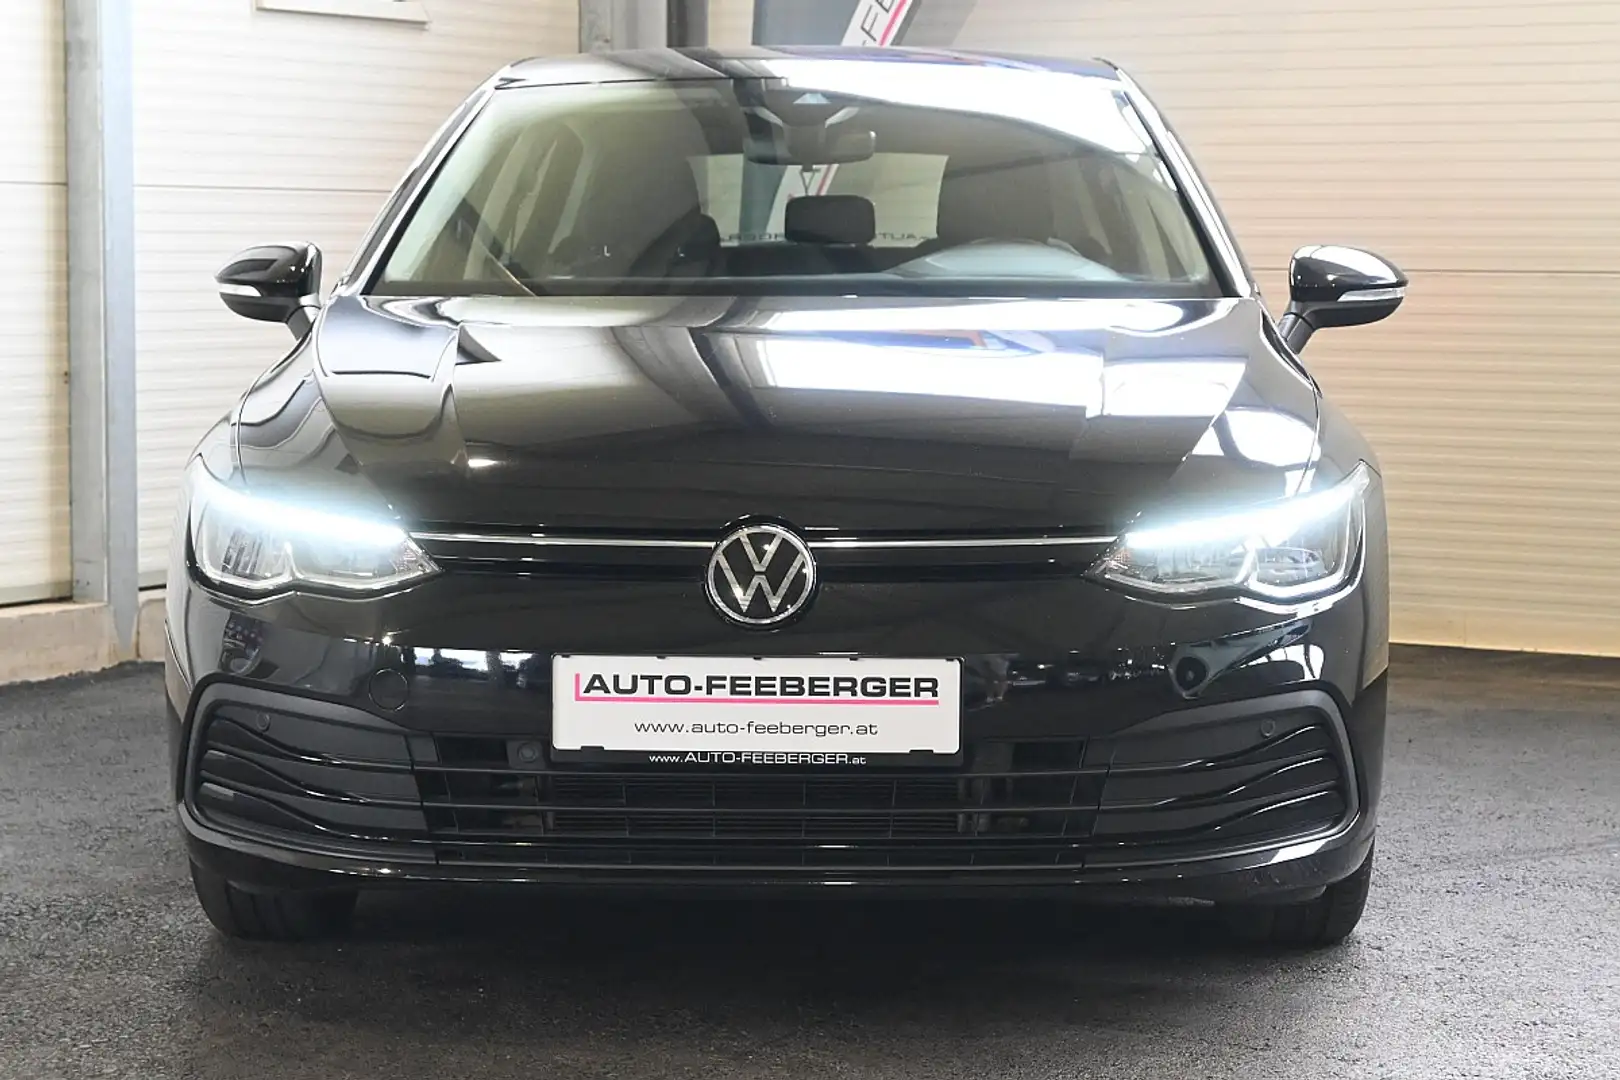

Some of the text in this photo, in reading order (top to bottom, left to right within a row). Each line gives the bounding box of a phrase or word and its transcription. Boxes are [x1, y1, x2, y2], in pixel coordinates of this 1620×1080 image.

[711, 528, 810, 619] VW
[583, 673, 939, 698] AUTO-FEEBERGER
[634, 721, 878, 737] www.auto-feeberger.at
[648, 751, 867, 765] www.AUTO-FEEBERGER.at
